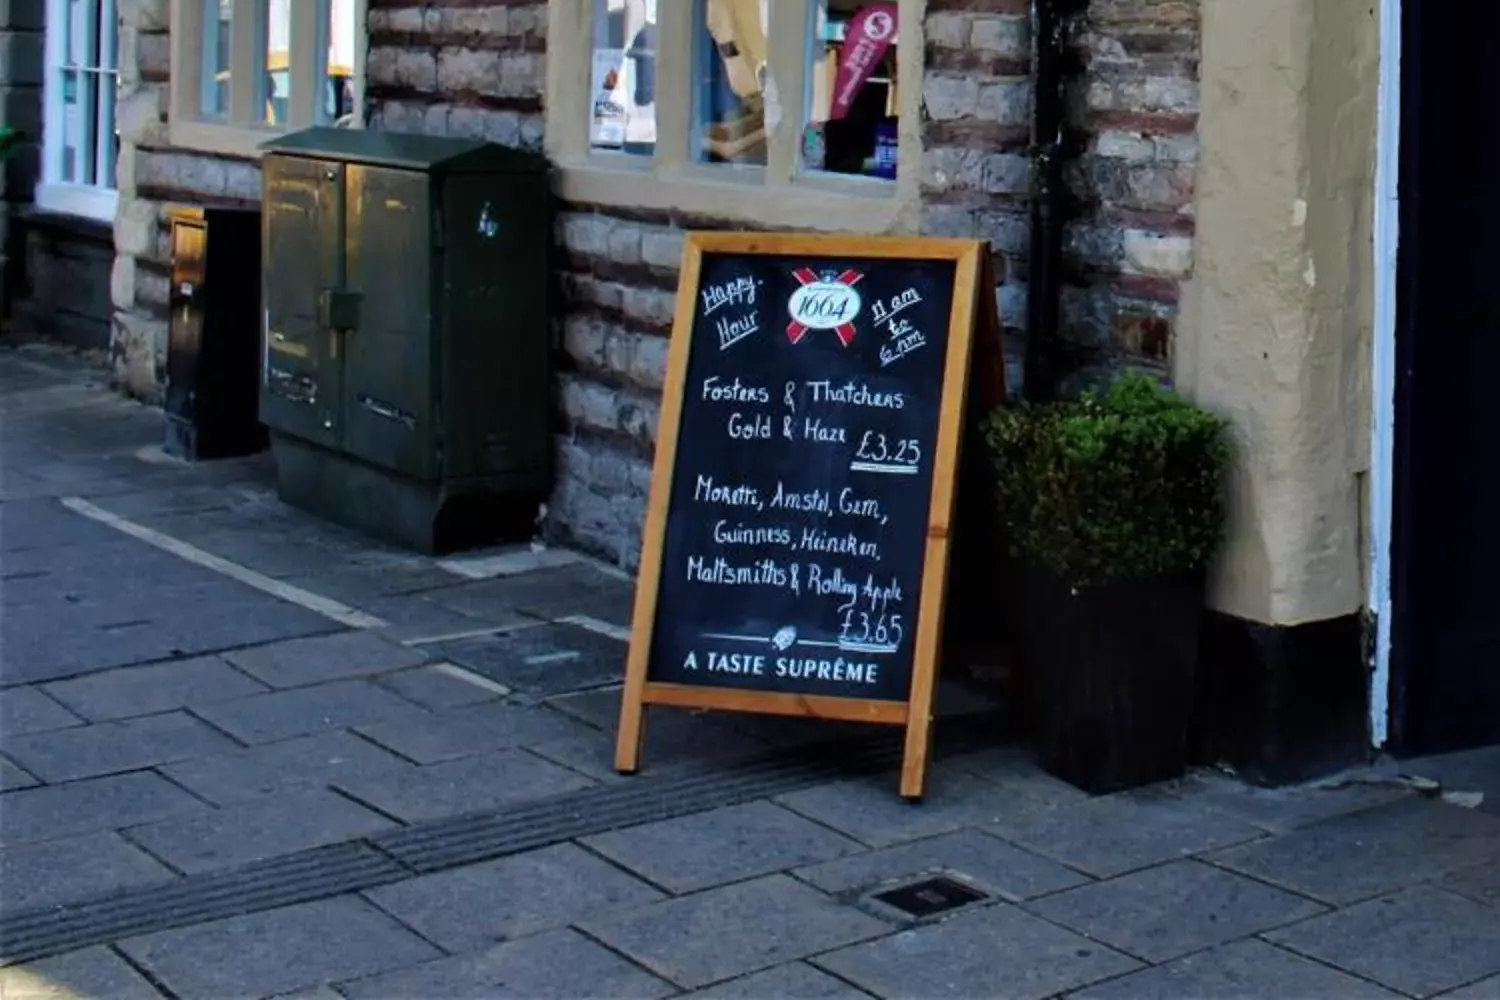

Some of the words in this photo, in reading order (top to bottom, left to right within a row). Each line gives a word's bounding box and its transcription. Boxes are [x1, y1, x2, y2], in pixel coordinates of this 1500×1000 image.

[798, 292, 850, 321] 1664
[716, 310, 758, 346] Hour
[889, 318, 909, 338] to
[702, 376, 770, 403] Fosters
[783, 380, 796, 413] &
[805, 379, 905, 409] Thatchers
[727, 412, 772, 440] Gold
[783, 415, 794, 441] &
[803, 417, 846, 443] Haze
[856, 430, 921, 465] £3.25
[687, 555, 787, 586] Maltsmiths
[789, 562, 800, 597] &
[807, 562, 858, 610] Rolling
[861, 572, 904, 612] Apple
[839, 607, 903, 646] £3.65
[683, 652, 698, 670] A
[706, 651, 766, 675] TASTE
[775, 656, 878, 684] SUPRÊME
